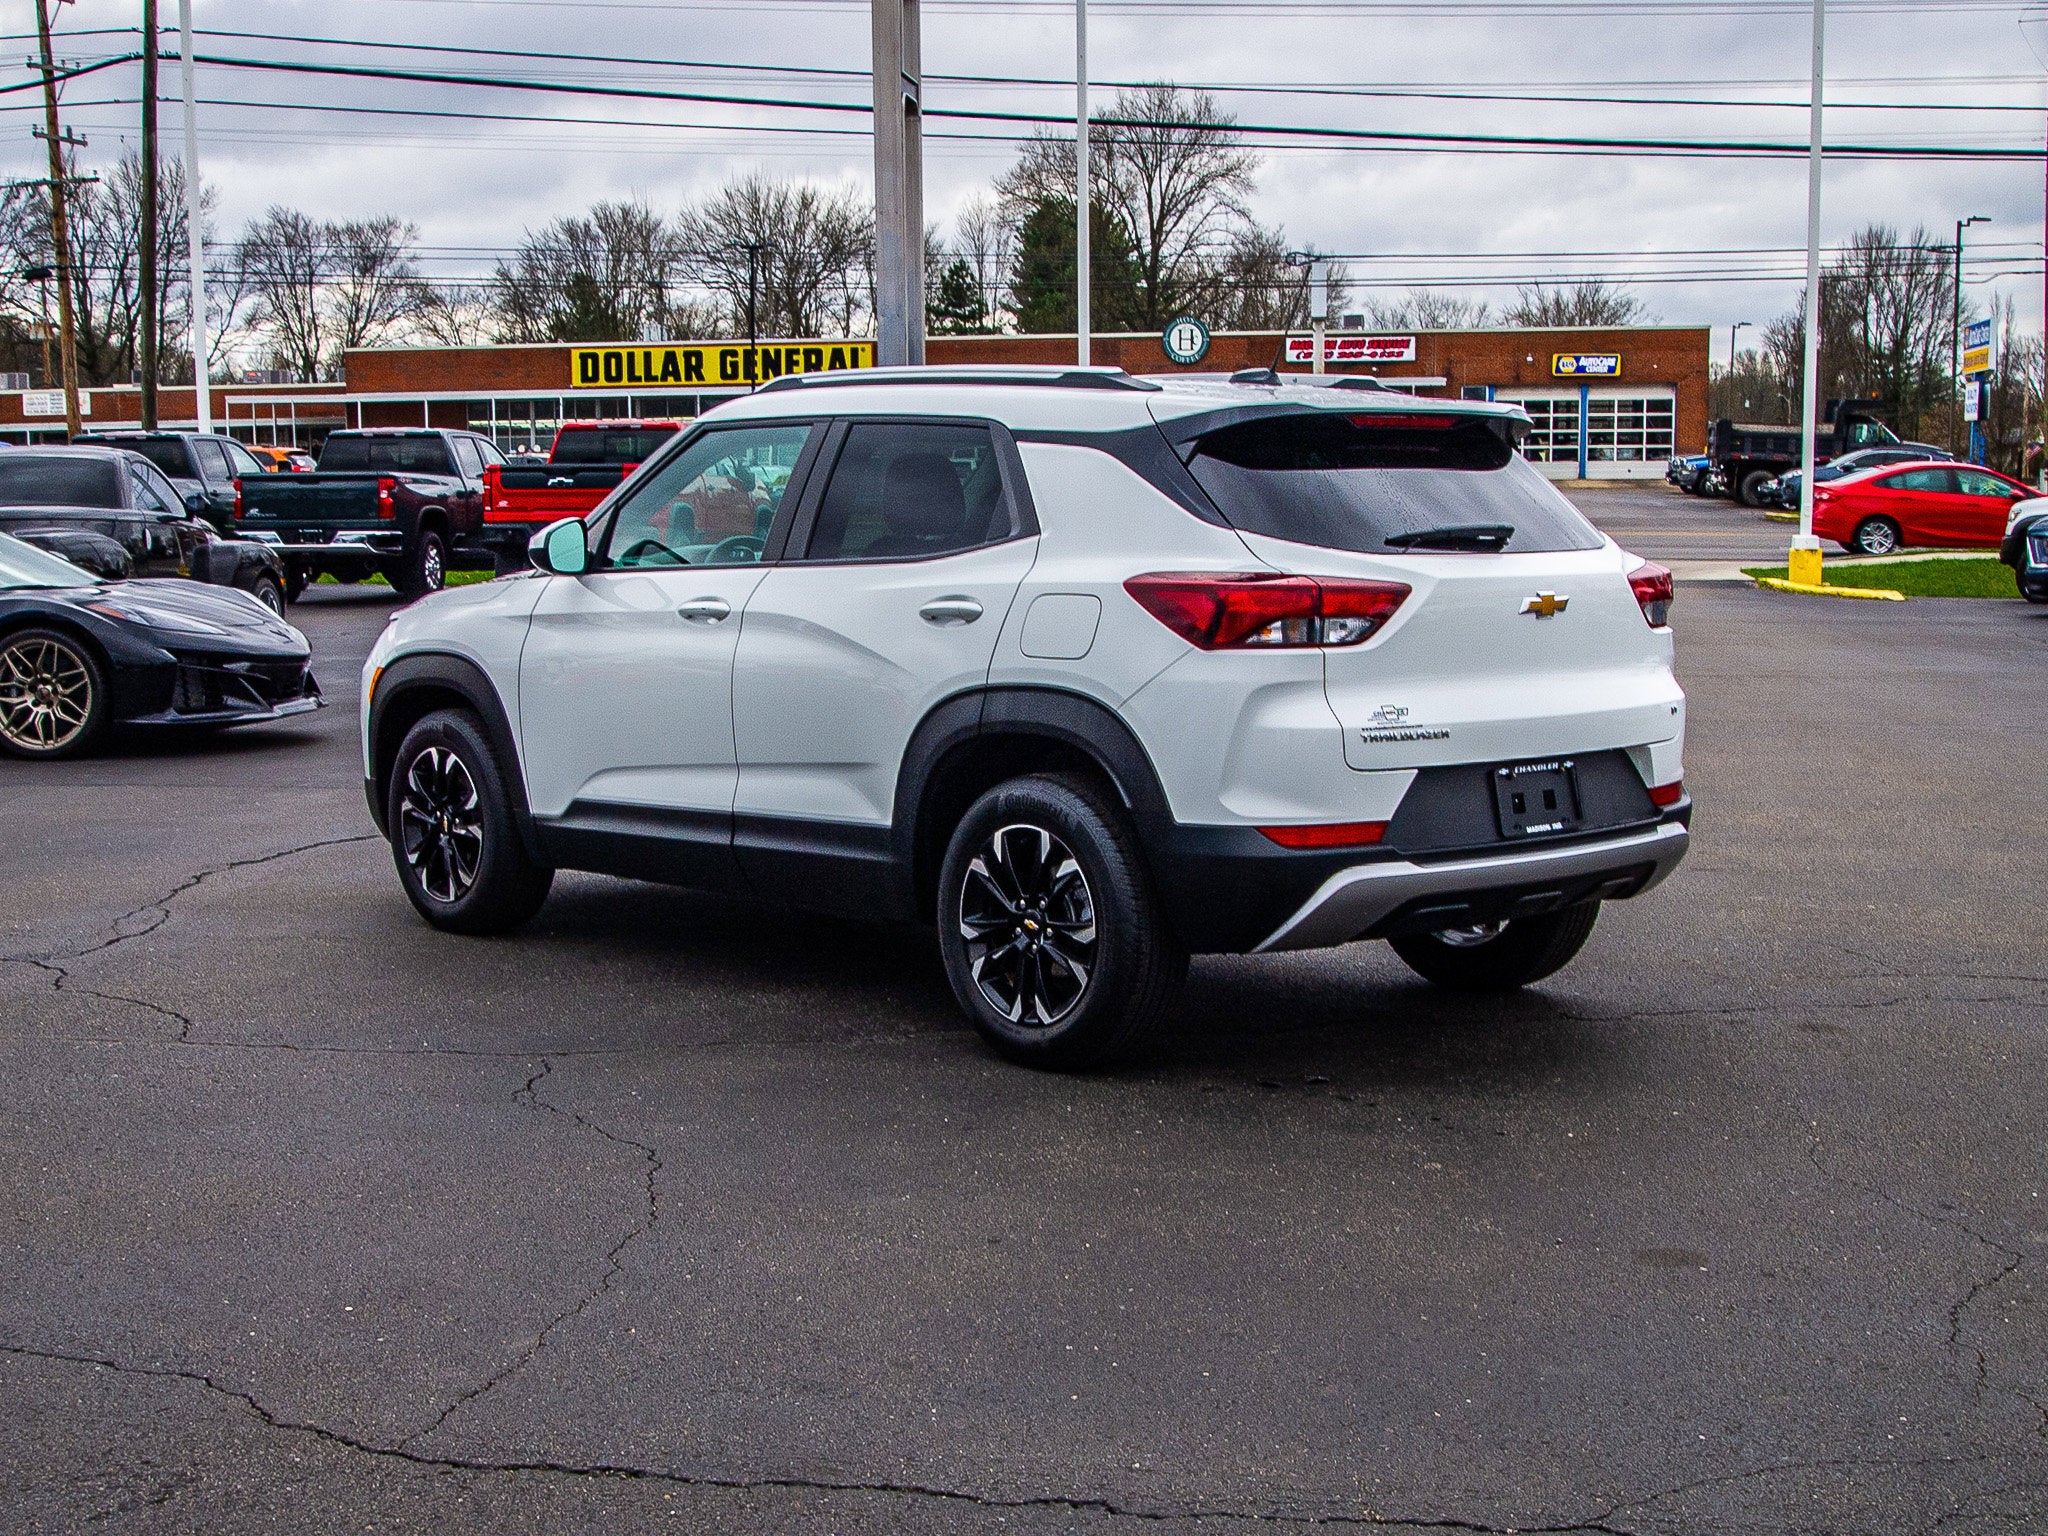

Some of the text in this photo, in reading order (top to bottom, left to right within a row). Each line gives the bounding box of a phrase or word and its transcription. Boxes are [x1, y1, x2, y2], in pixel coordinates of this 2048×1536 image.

[1338, 339, 1366, 350] AUTO
[1367, 338, 1411, 350] SERVICE
[1170, 353, 1201, 364] COFFEE
[579, 350, 705, 384] DOLLAR
[1361, 729, 1450, 743] TRAILBLAZER
[1514, 762, 1559, 774] CHANDLER
